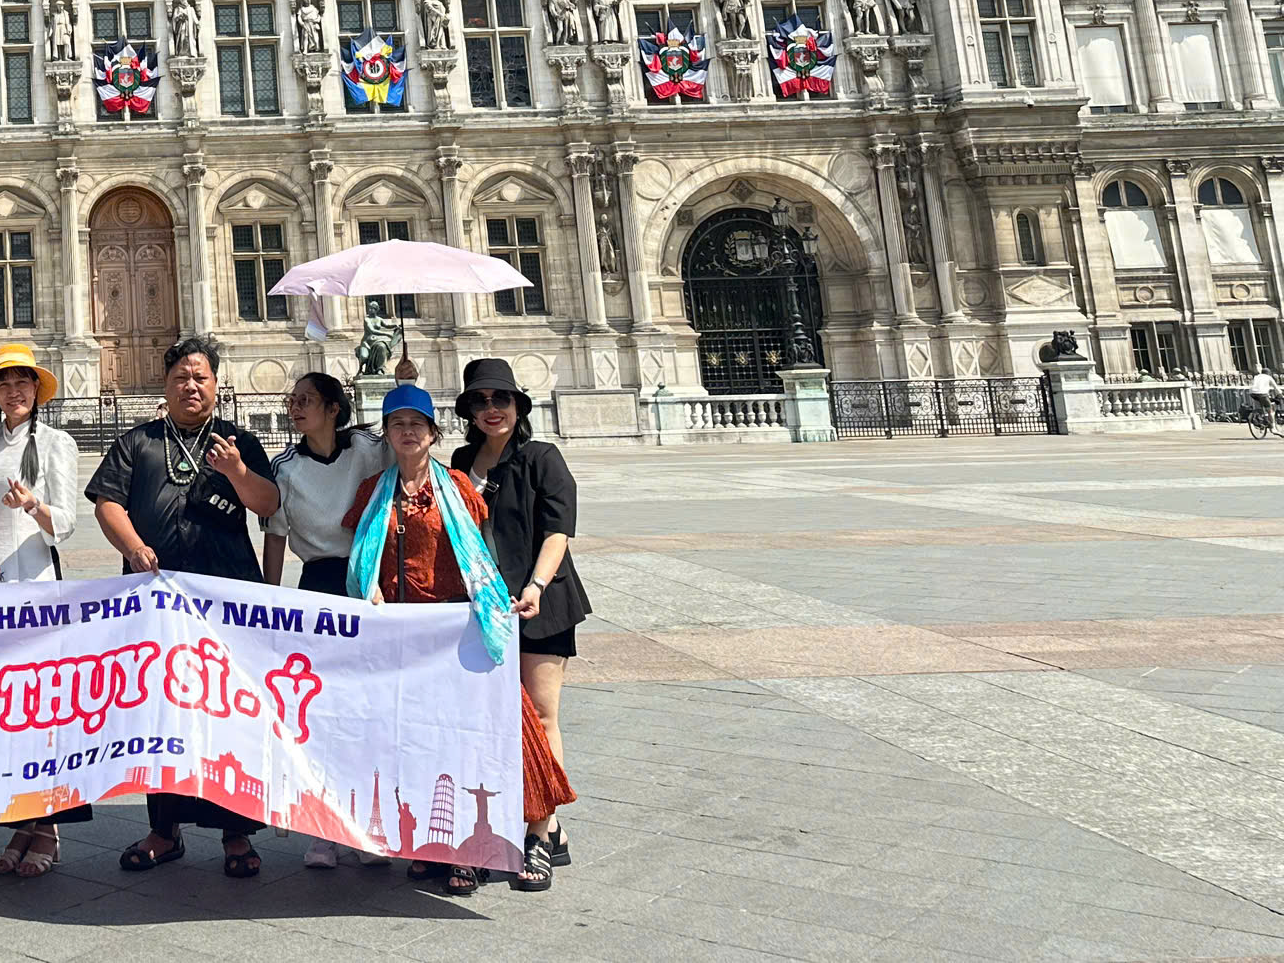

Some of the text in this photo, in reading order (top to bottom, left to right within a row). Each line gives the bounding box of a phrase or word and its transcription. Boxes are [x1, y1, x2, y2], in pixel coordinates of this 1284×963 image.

[80, 590, 142, 623] PHÁ
[222, 601, 304, 633] NAM
[313, 607, 361, 638] ÂU
[164, 637, 231, 718] SĨ
[22, 737, 185, 781] 04/07/2026
